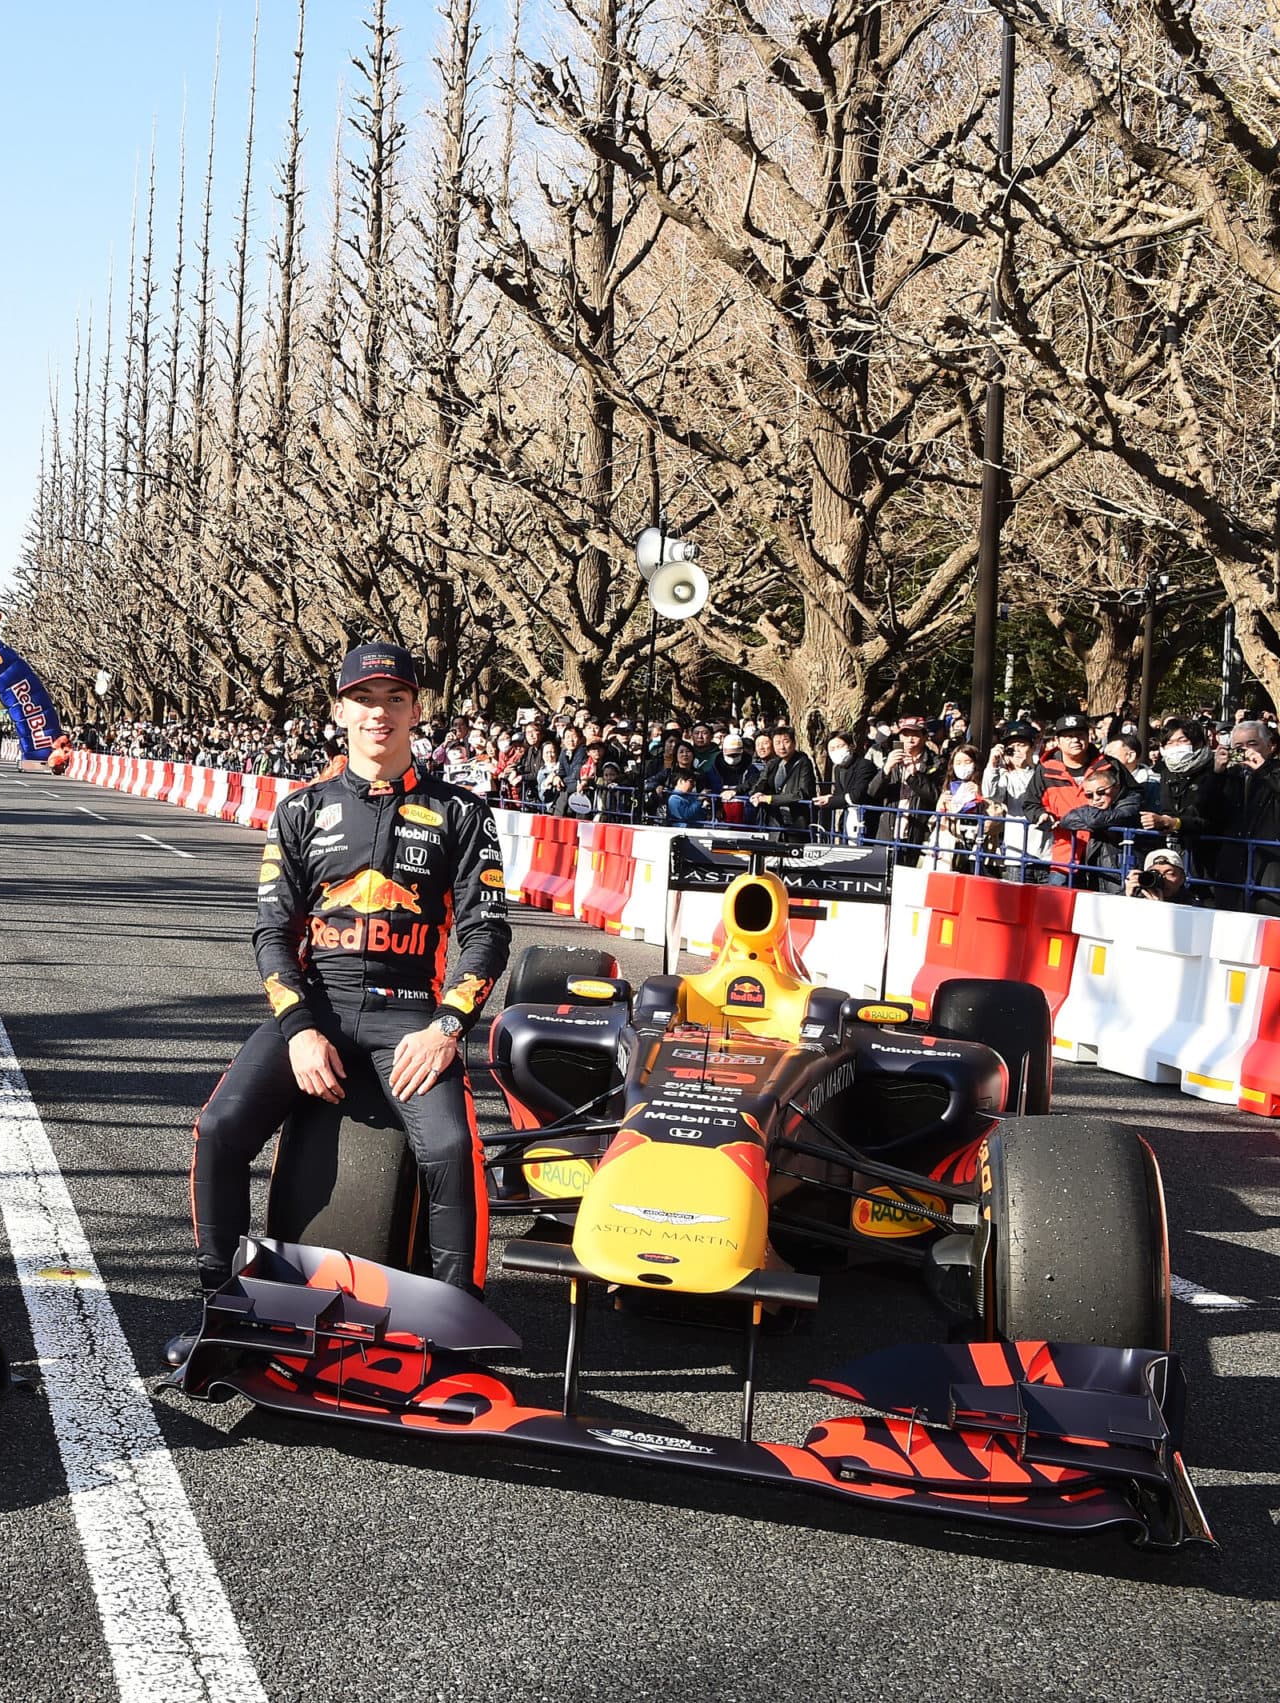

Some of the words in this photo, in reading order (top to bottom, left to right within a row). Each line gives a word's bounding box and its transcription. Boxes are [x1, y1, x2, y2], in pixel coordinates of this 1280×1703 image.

[10, 678, 43, 717] Red
[26, 713, 54, 750] Bull
[410, 810, 437, 823] RAUCH
[395, 826, 428, 842] Mobil
[684, 871, 734, 882] AST
[783, 876, 882, 892] MARTIN
[310, 917, 363, 950] Red
[368, 918, 429, 955] Bull
[730, 991, 746, 1000] Red
[747, 993, 763, 1002] Bull
[871, 1010, 902, 1020] RAUCH
[644, 1112, 710, 1125] Mobil
[543, 1163, 590, 1192] RAUCH
[592, 1224, 653, 1237] ASTON
[661, 1231, 738, 1251] MARTIN
